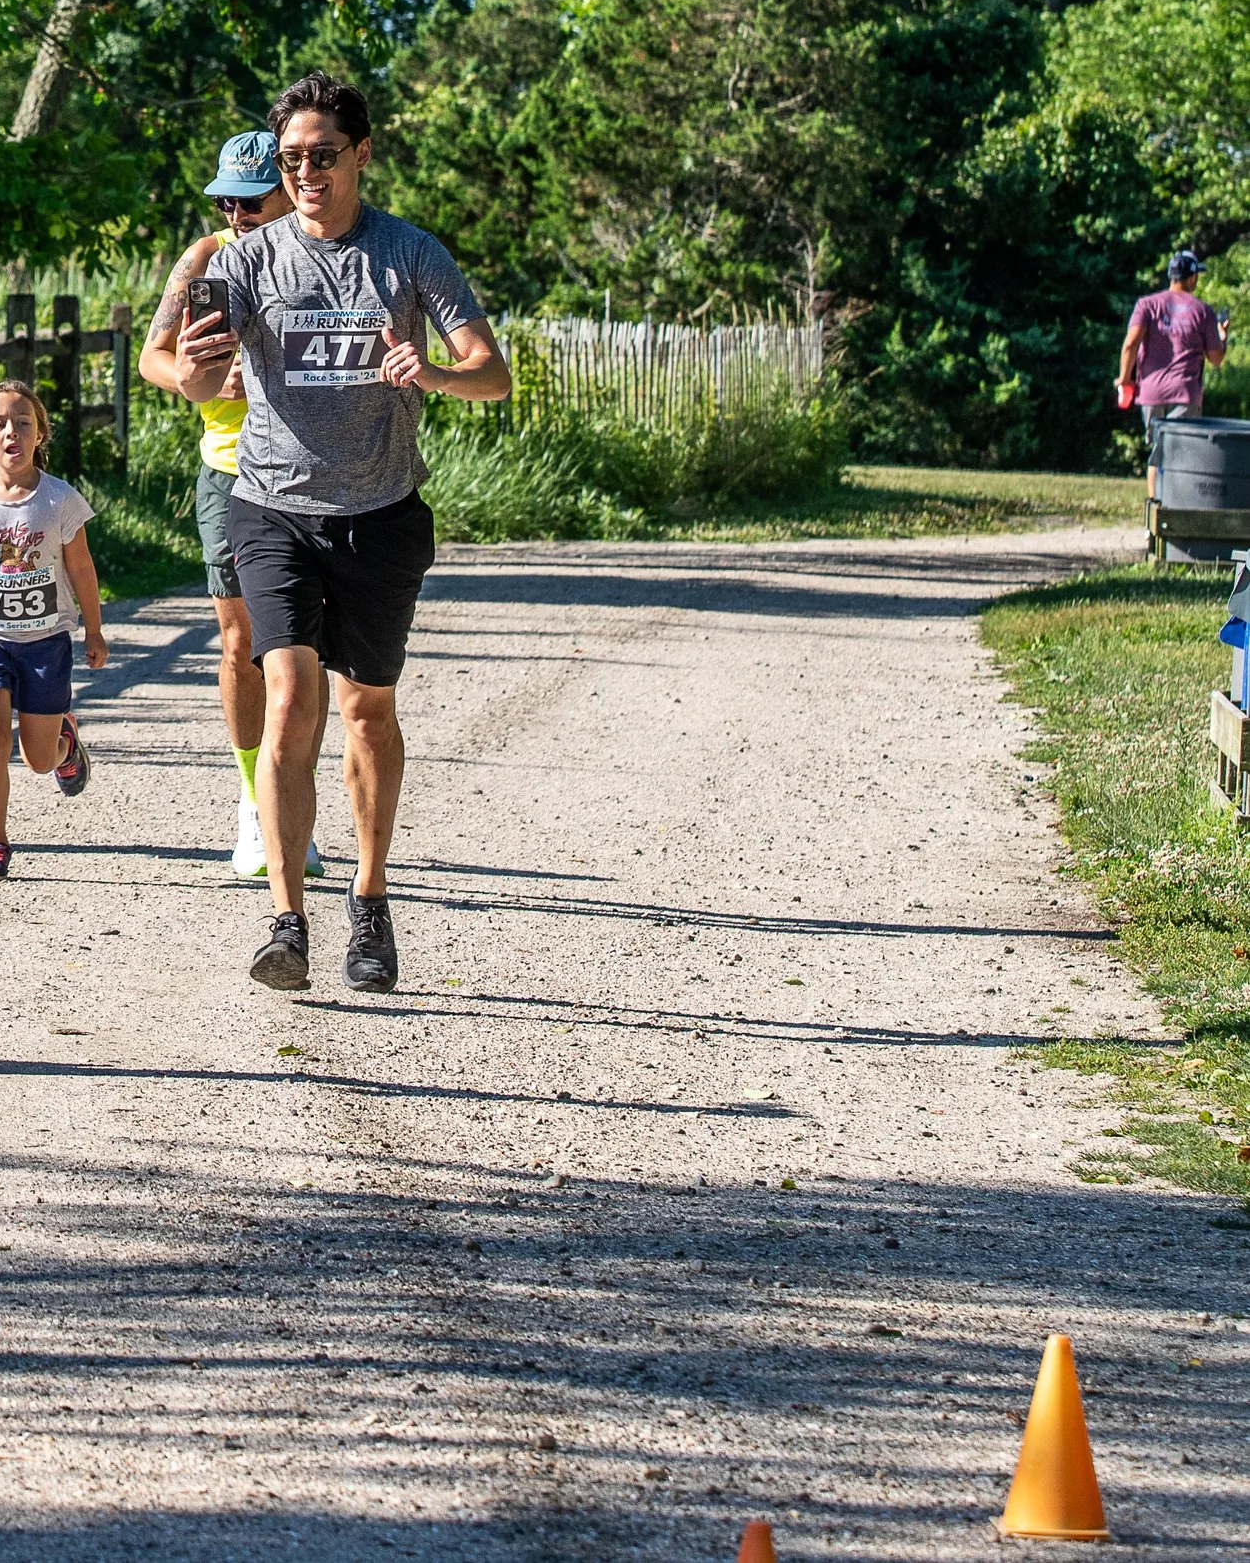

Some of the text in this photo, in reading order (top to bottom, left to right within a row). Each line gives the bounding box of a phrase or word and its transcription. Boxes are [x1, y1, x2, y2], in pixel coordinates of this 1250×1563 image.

[317, 317, 386, 329] RUNNERS
[301, 335, 376, 366] 477
[303, 371, 375, 381] Race Series '24
[34, 567, 50, 576] ROAD
[6, 619, 31, 629] Series
